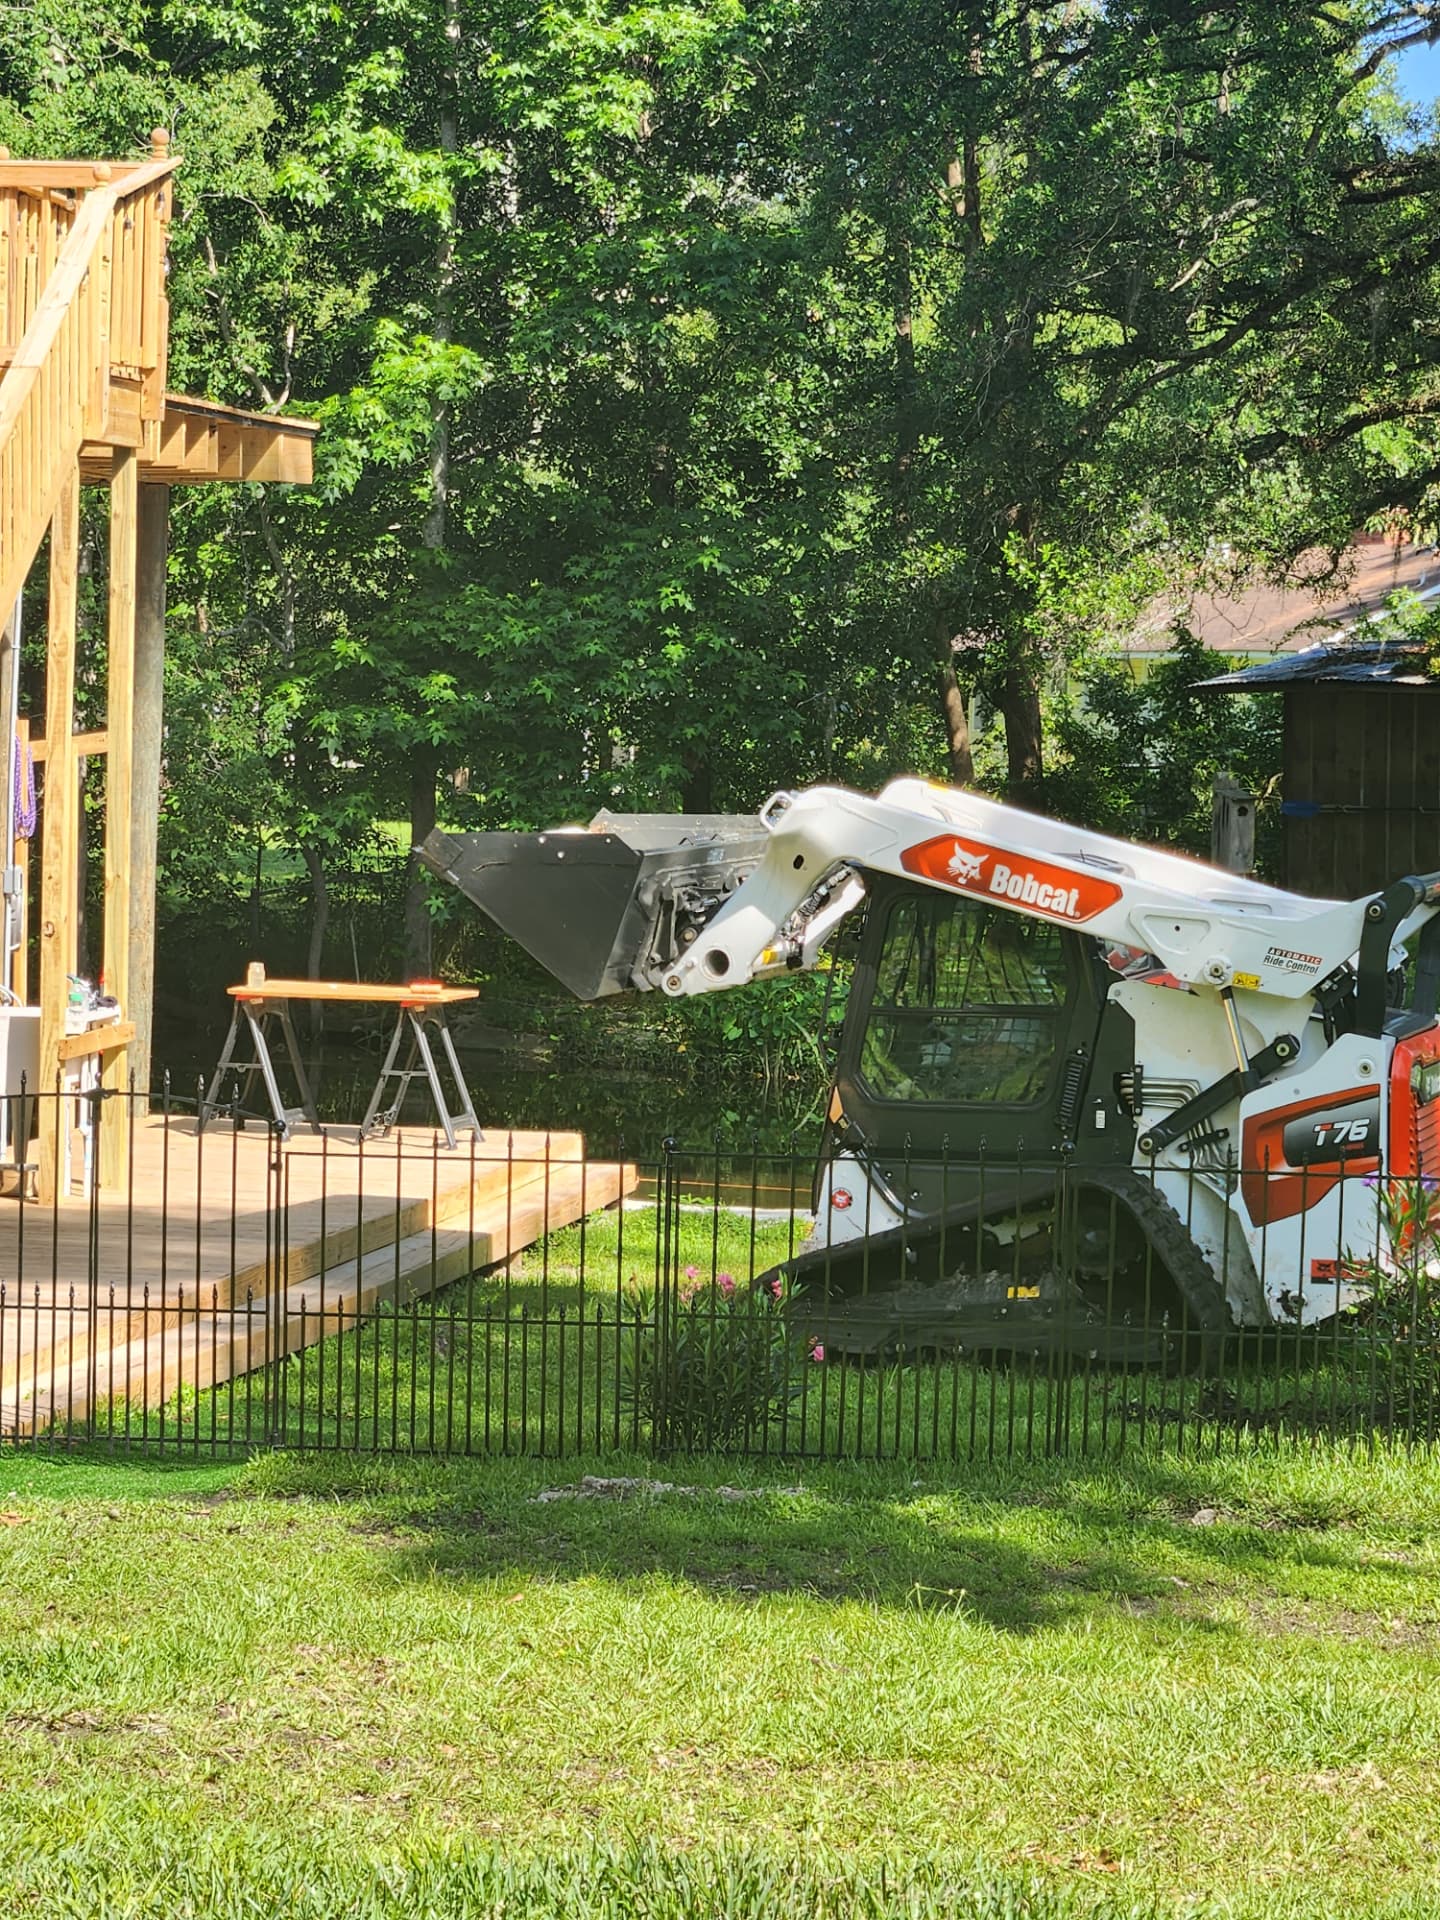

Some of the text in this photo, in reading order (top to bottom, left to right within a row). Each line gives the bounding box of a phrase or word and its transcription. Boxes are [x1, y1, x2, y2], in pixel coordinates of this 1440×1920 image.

[989, 863, 1079, 917] Bobcat
[1264, 955, 1320, 974] Ride Control
[1269, 948, 1321, 965] AUTOMATIC
[1314, 1118, 1370, 1146] T76
